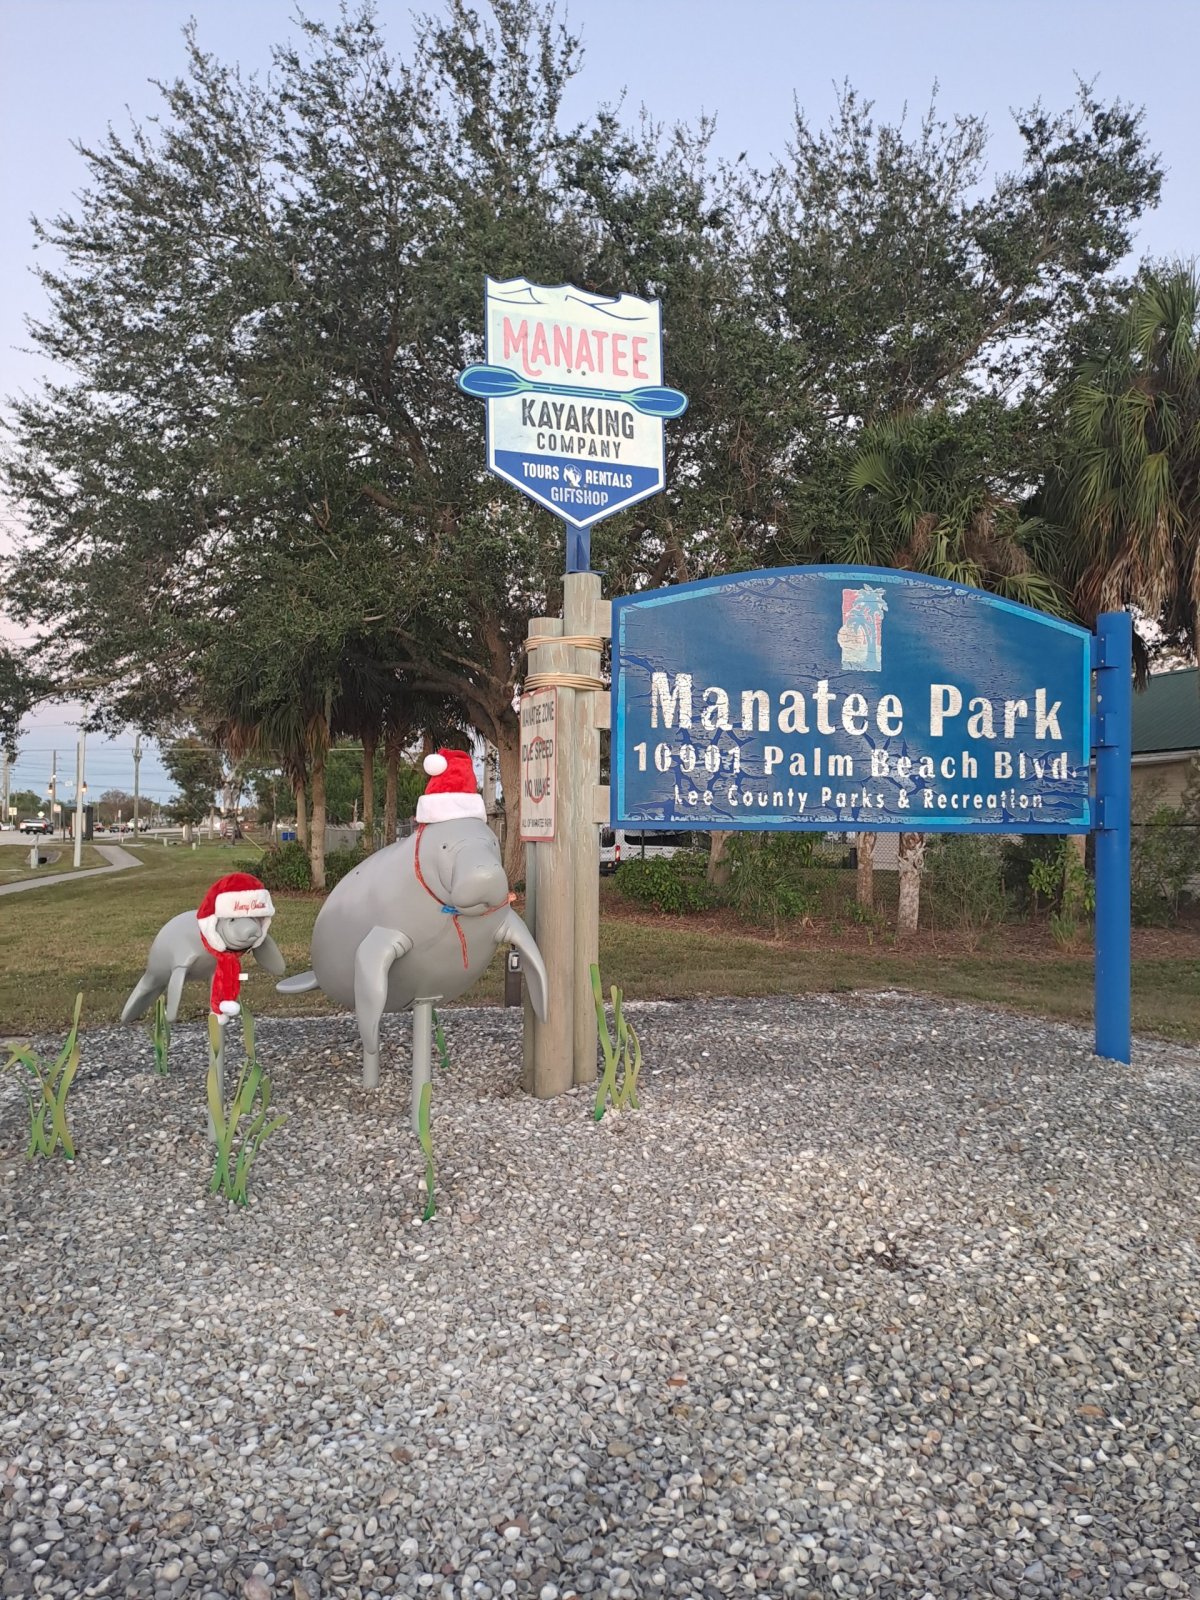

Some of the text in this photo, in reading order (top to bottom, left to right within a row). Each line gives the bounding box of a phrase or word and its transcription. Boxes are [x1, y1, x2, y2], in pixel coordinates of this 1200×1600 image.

[503, 317, 649, 379] MANATEE
[522, 398, 634, 440] KAYAKING
[537, 432, 621, 459] COMPANY
[522, 462, 633, 489] TOURS RENTALS
[551, 486, 609, 507] GIFTSHOP
[651, 672, 1063, 740] Manatee Park
[633, 742, 741, 774] 10901
[763, 745, 853, 777] Palm
[870, 748, 978, 779] Beach
[674, 784, 1043, 813] Lee County Parks & Recreation
